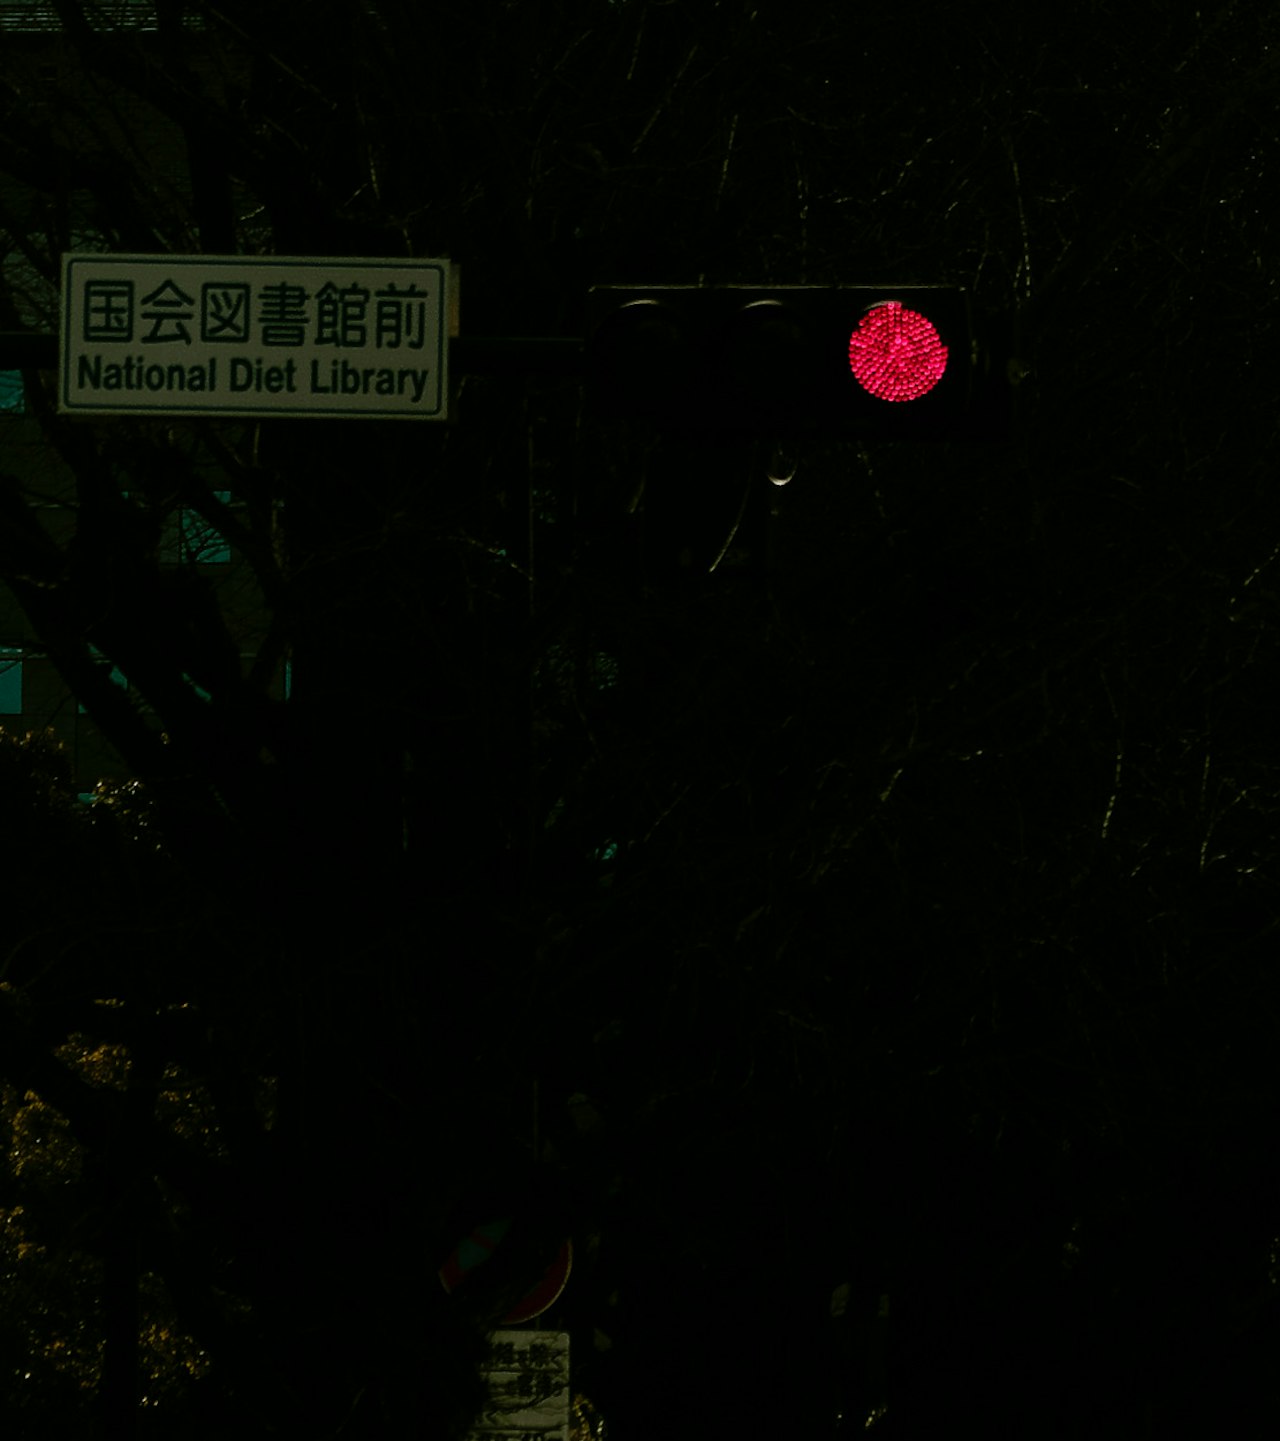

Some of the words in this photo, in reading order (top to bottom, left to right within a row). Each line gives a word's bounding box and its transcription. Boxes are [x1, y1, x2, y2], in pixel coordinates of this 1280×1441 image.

[84, 280, 428, 350] 国会図書館前
[78, 355, 216, 392] National
[230, 358, 296, 394] Diet
[310, 360, 428, 403] Library
